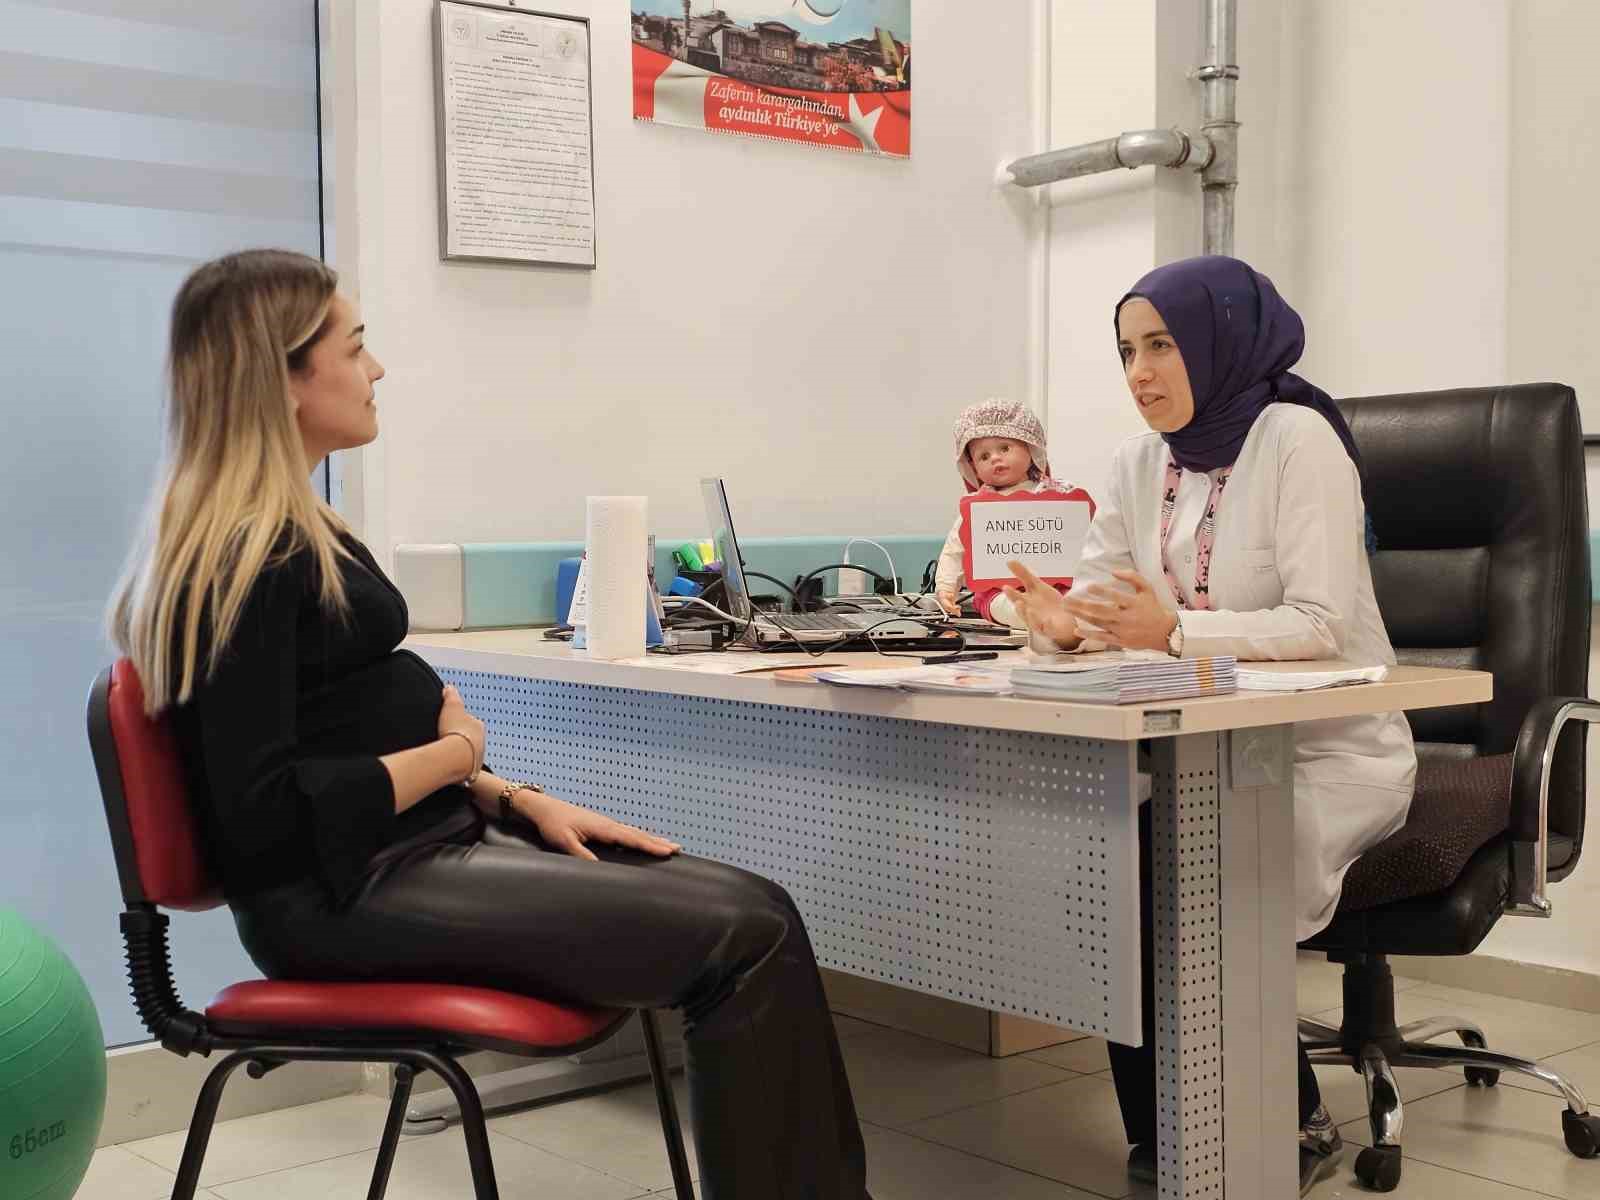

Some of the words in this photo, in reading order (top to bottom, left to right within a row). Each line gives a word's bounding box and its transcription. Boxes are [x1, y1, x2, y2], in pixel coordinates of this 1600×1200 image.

[710, 81, 754, 104] Zaferin
[757, 88, 845, 119] karargahından,
[719, 105, 772, 125] aydınlık
[775, 111, 838, 137] Türkiye'ye
[986, 519, 1025, 532] ANNE
[1027, 517, 1063, 531] SÜTÜ
[986, 541, 1063, 555] MUCİZEDİR
